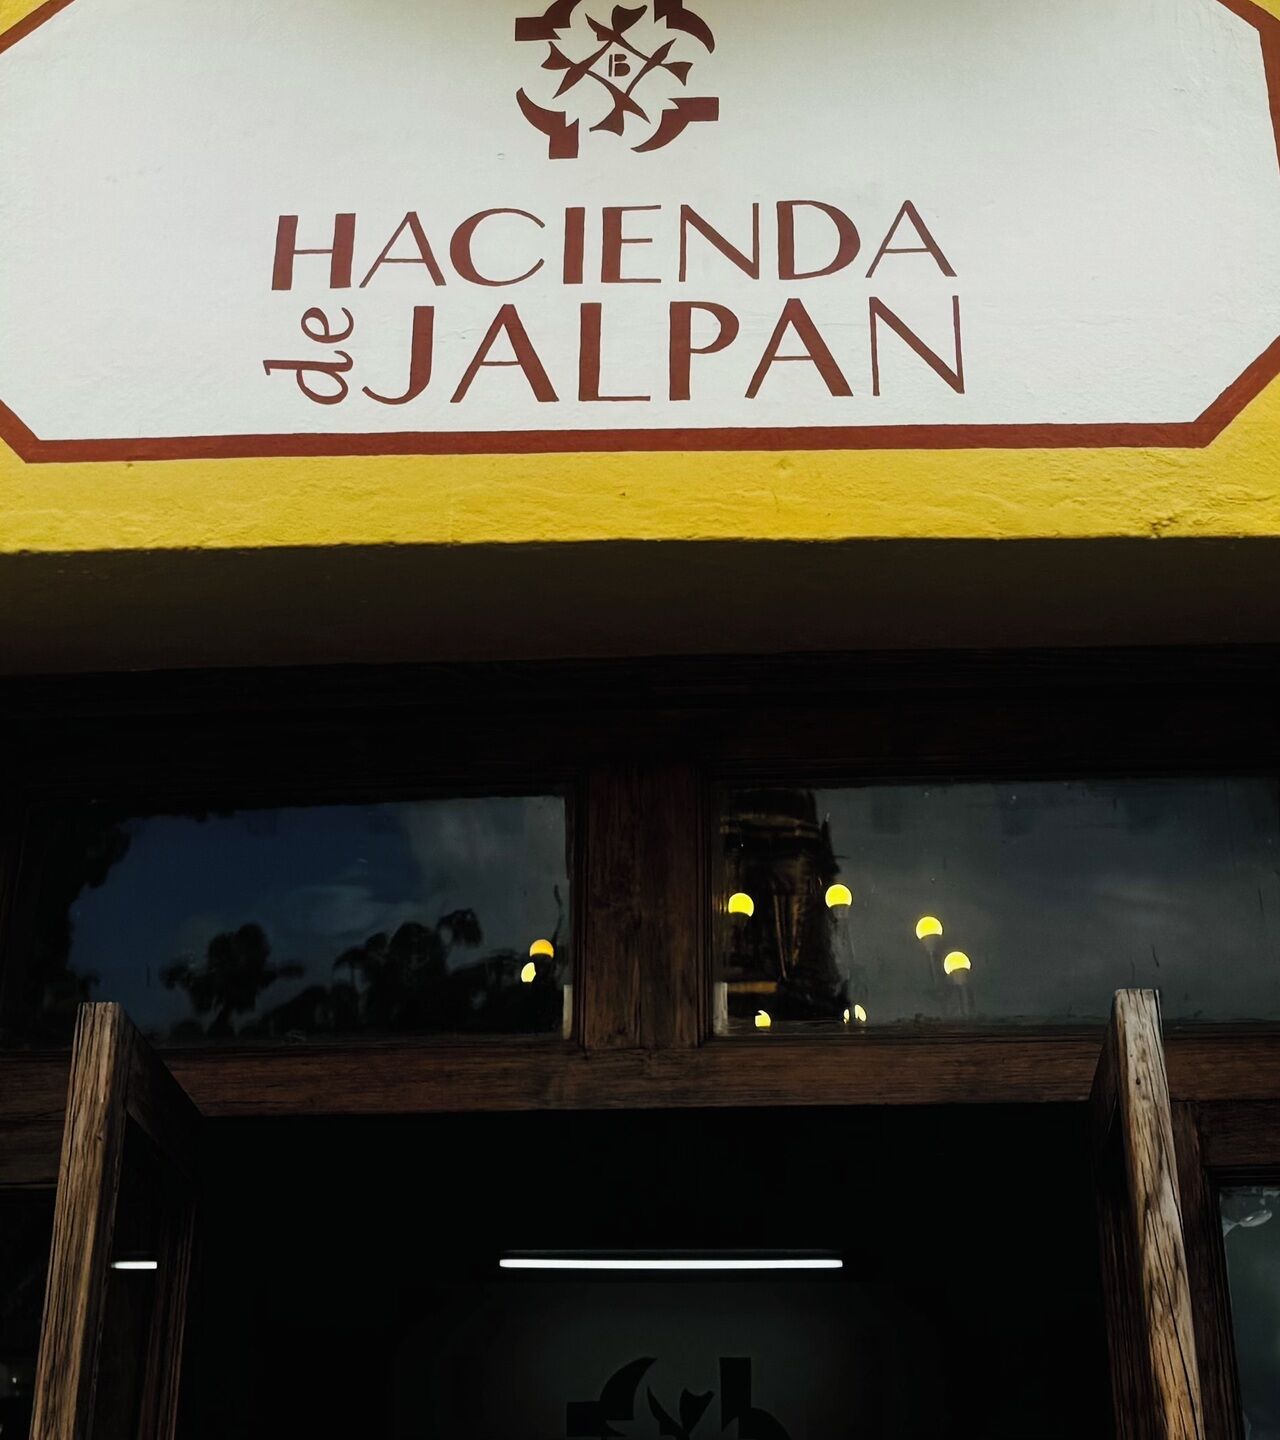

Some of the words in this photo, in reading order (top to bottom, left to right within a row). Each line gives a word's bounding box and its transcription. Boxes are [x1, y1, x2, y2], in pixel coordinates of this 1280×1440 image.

[271, 200, 958, 290] HACIENDA
[264, 306, 354, 405] de
[362, 295, 965, 405] JALPAN
